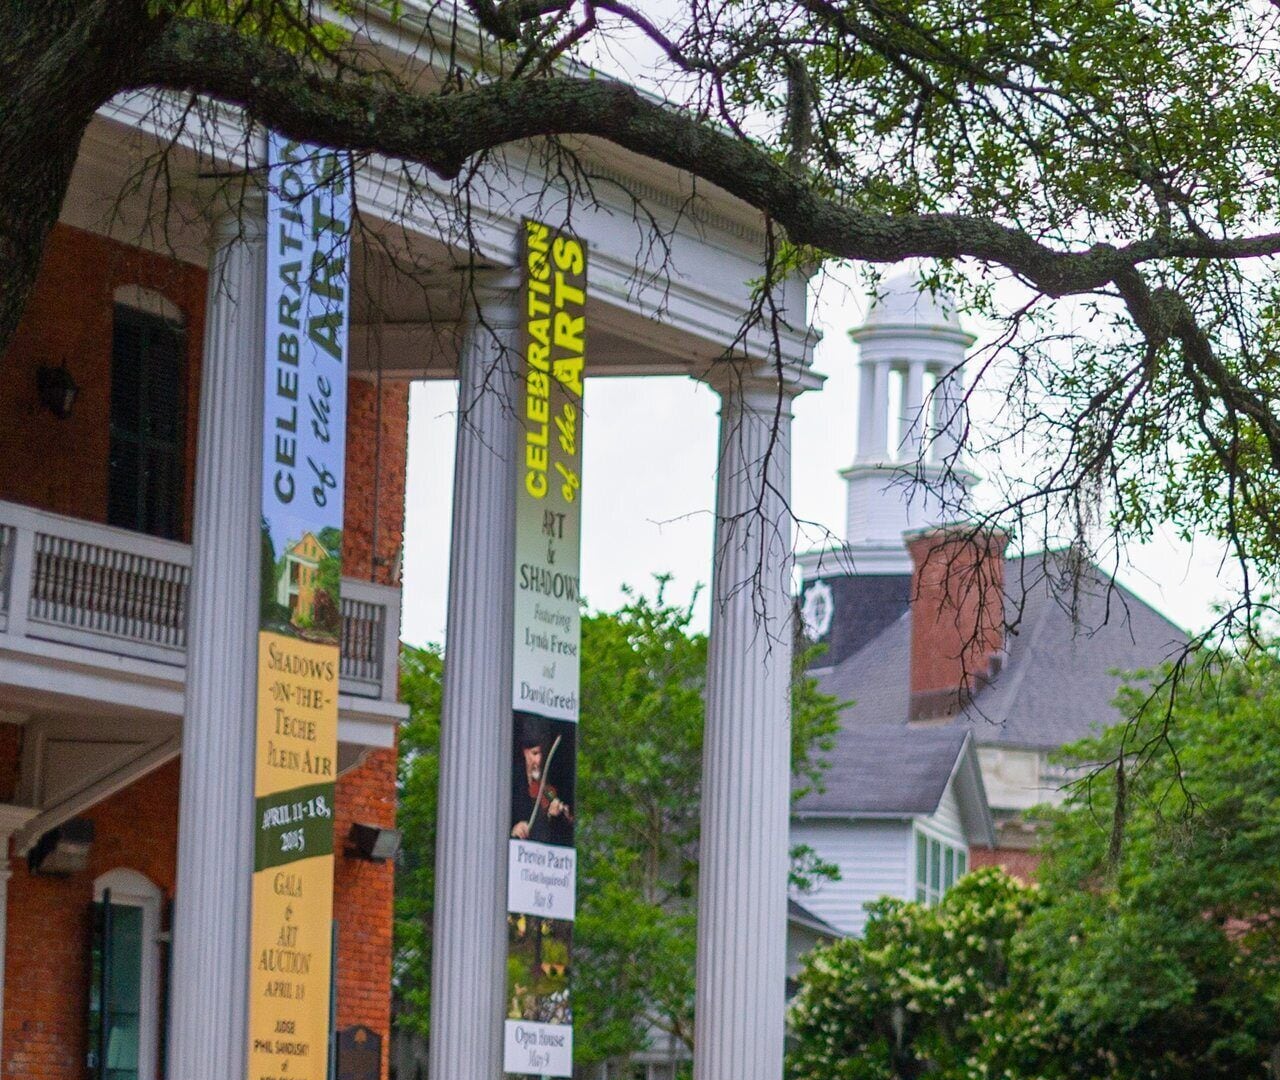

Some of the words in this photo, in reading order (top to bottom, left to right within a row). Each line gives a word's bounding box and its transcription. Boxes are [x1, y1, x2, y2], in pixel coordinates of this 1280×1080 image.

[308, 150, 346, 363] ARTS
[274, 139, 304, 504] CELEBRATION
[552, 236, 584, 397] ARTS
[525, 220, 551, 499] CELEBRATION
[308, 375, 332, 444] the
[554, 403, 577, 456] the
[307, 456, 337, 507] of
[554, 461, 579, 503] of
[542, 508, 566, 539] ART
[268, 642, 335, 682] SHADOWS
[274, 707, 317, 743] TECHE
[301, 748, 333, 777] AIR
[258, 949, 312, 976] AUCTION
